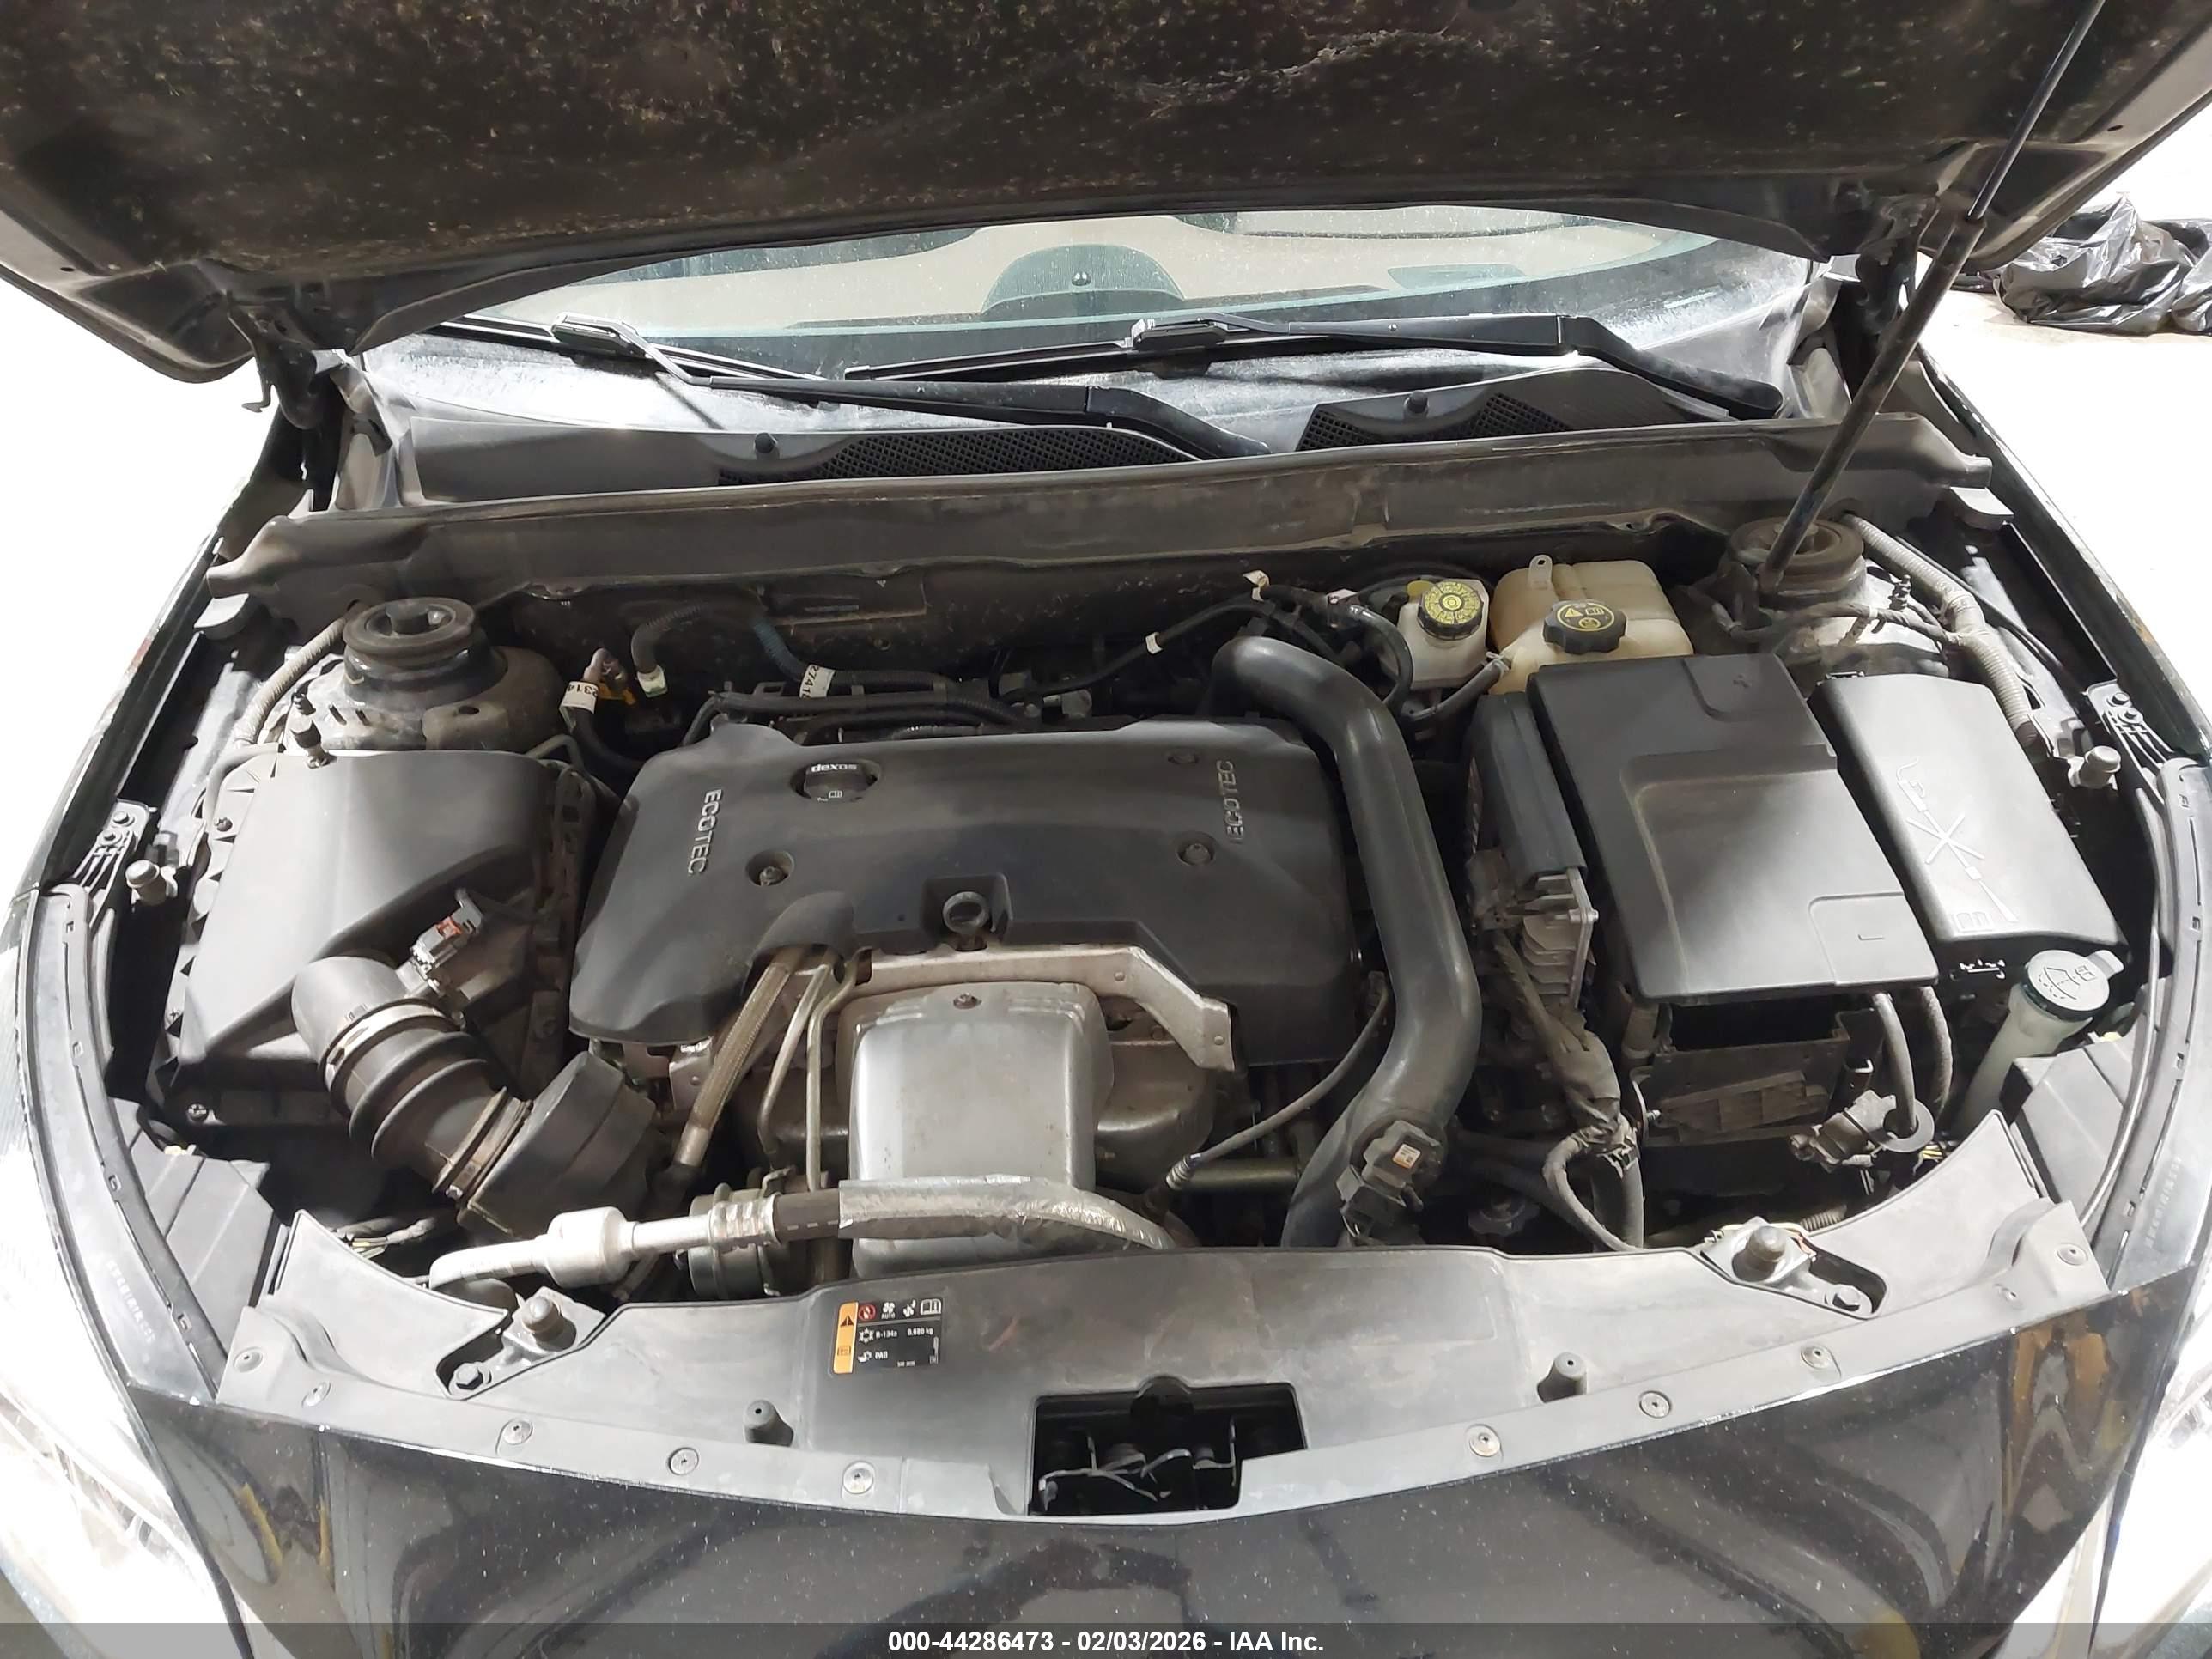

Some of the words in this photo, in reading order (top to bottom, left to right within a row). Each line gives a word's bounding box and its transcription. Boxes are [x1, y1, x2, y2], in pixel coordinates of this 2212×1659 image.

[811, 763, 858, 773] dexos
[1216, 759, 1244, 841] ECOTEC
[688, 788, 722, 874] ECOTEC
